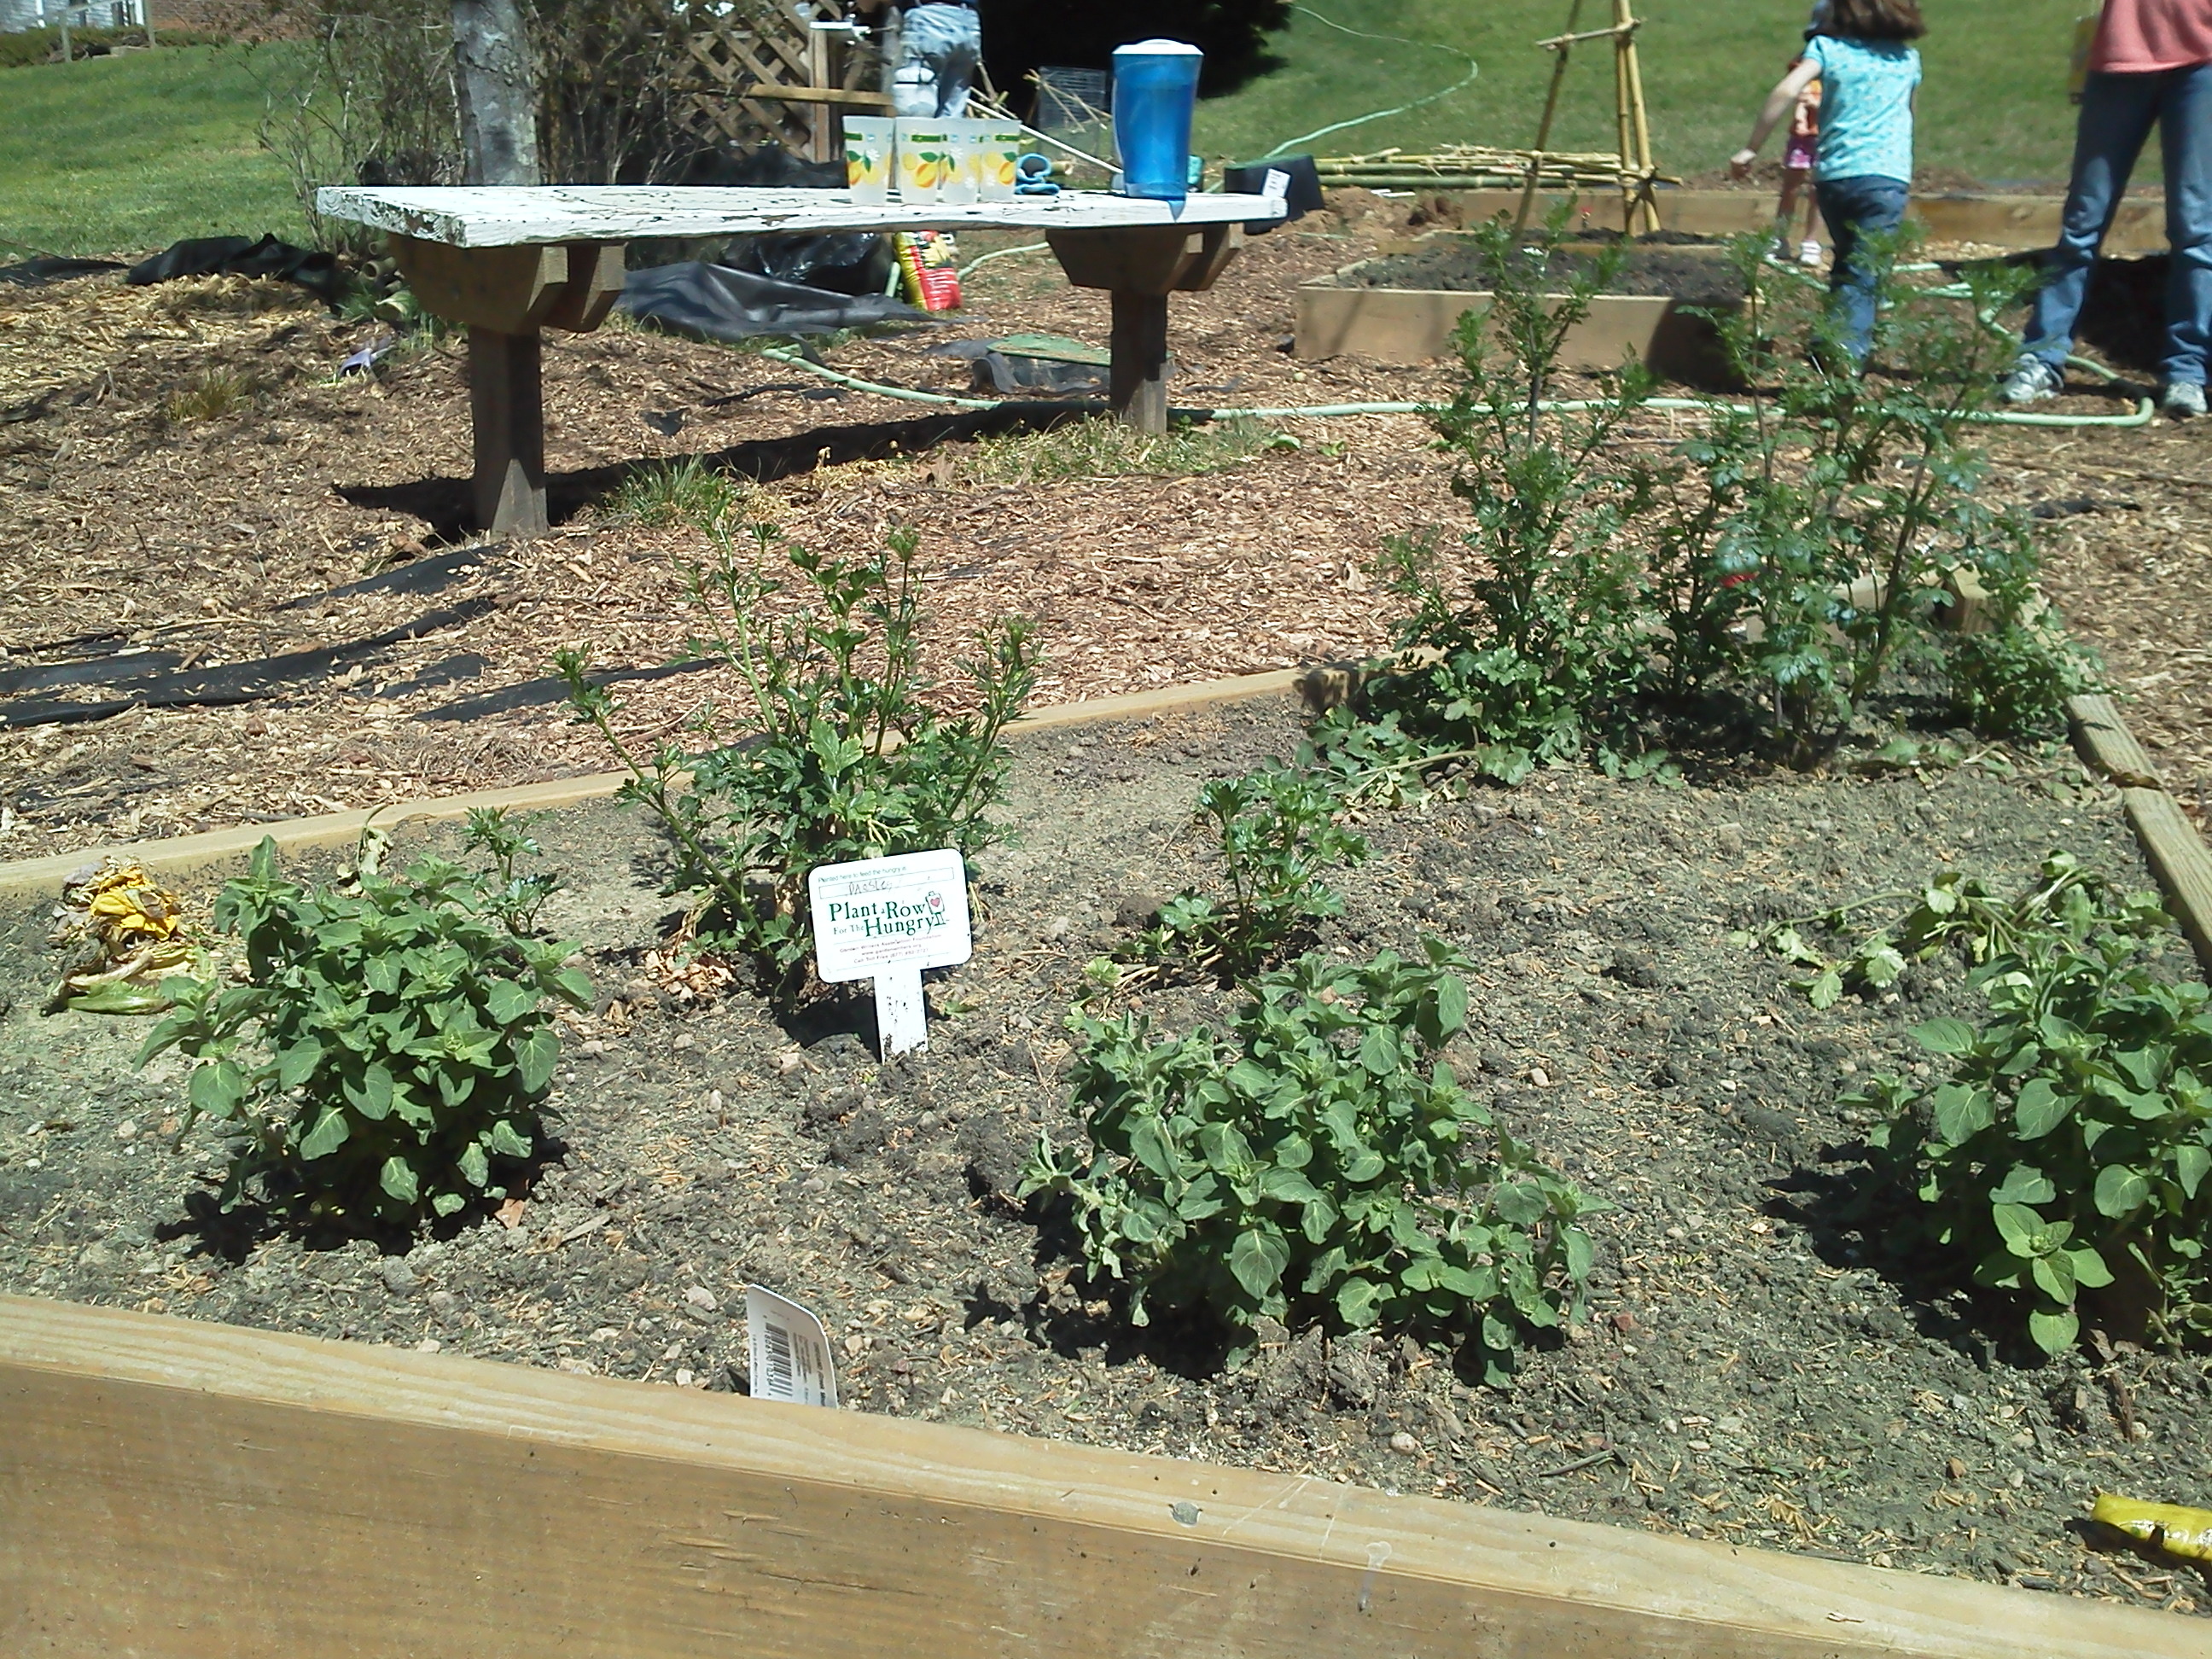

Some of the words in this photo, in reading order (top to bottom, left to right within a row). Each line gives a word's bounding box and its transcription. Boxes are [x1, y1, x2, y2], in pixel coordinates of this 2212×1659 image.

[829, 901, 877, 922] Plant
[885, 900, 926, 919] Row
[833, 927, 847, 935] For
[849, 924, 864, 933] The
[864, 917, 934, 937] Hungry
